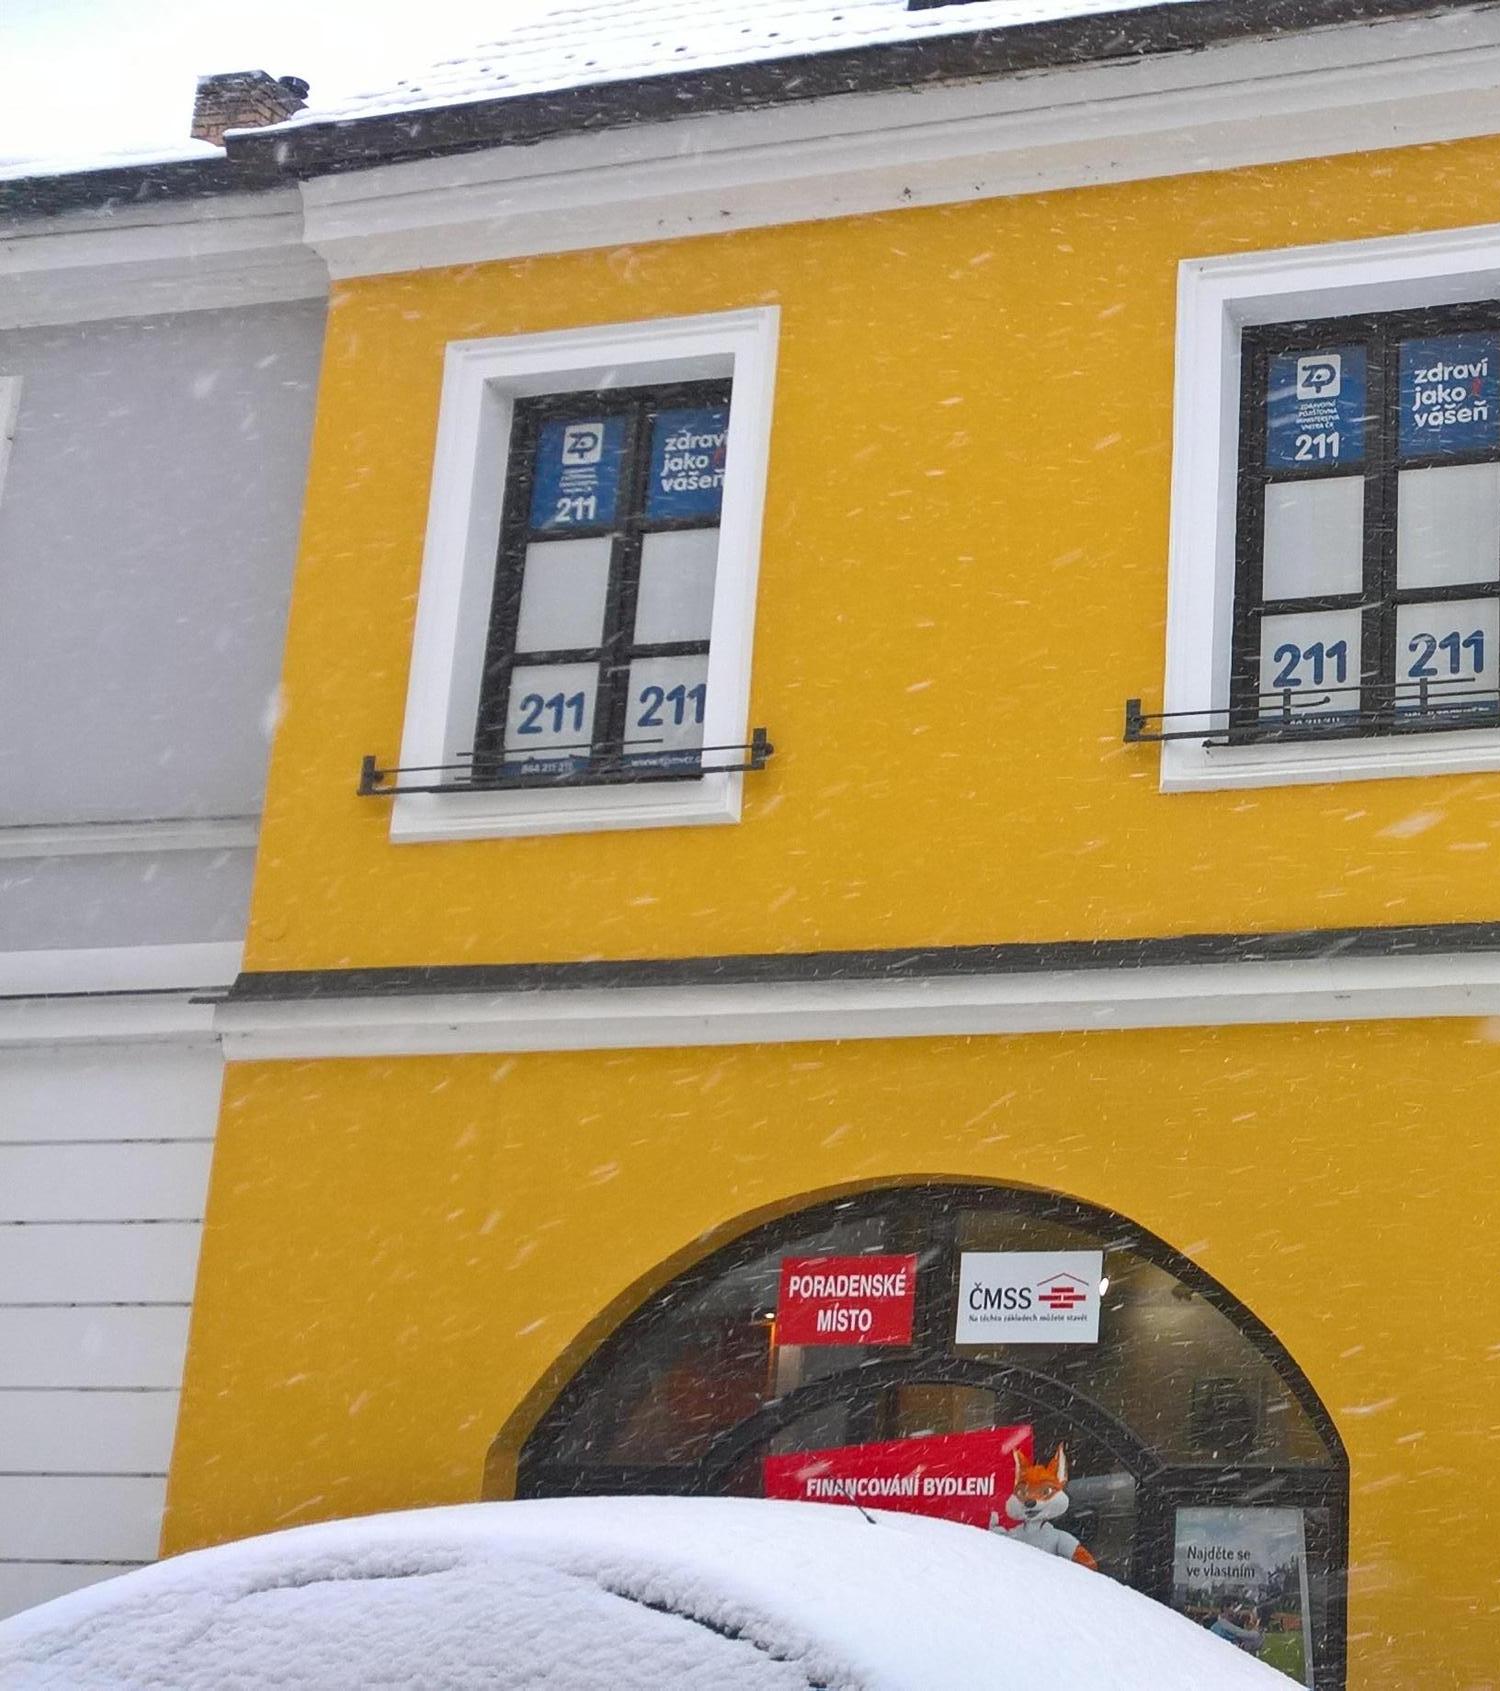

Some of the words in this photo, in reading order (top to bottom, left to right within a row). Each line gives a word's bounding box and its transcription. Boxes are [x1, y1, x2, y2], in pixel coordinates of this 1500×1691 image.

[1413, 356, 1489, 385] zdraví
[1411, 386, 1467, 411] jako
[1413, 400, 1488, 428] vášeň
[1294, 431, 1340, 461] 211
[660, 453, 710, 477] jako
[555, 495, 597, 523] 211
[1273, 640, 1348, 688] 211
[1408, 630, 1485, 678] 211
[517, 691, 586, 735] 211
[637, 683, 707, 728] 211
[789, 1267, 907, 1299] PORADENSKÉ
[968, 1281, 1032, 1311] ČMSS
[817, 1303, 873, 1333] MÍSTO
[806, 1473, 920, 1498] FINANCOVÁNÍ
[922, 1472, 996, 1497] BYDLENÍ
[1186, 1545, 1234, 1563] Najděte
[1237, 1550, 1251, 1561] se
[1186, 1567, 1201, 1578] ve
[1203, 1563, 1256, 1578] vlastním
